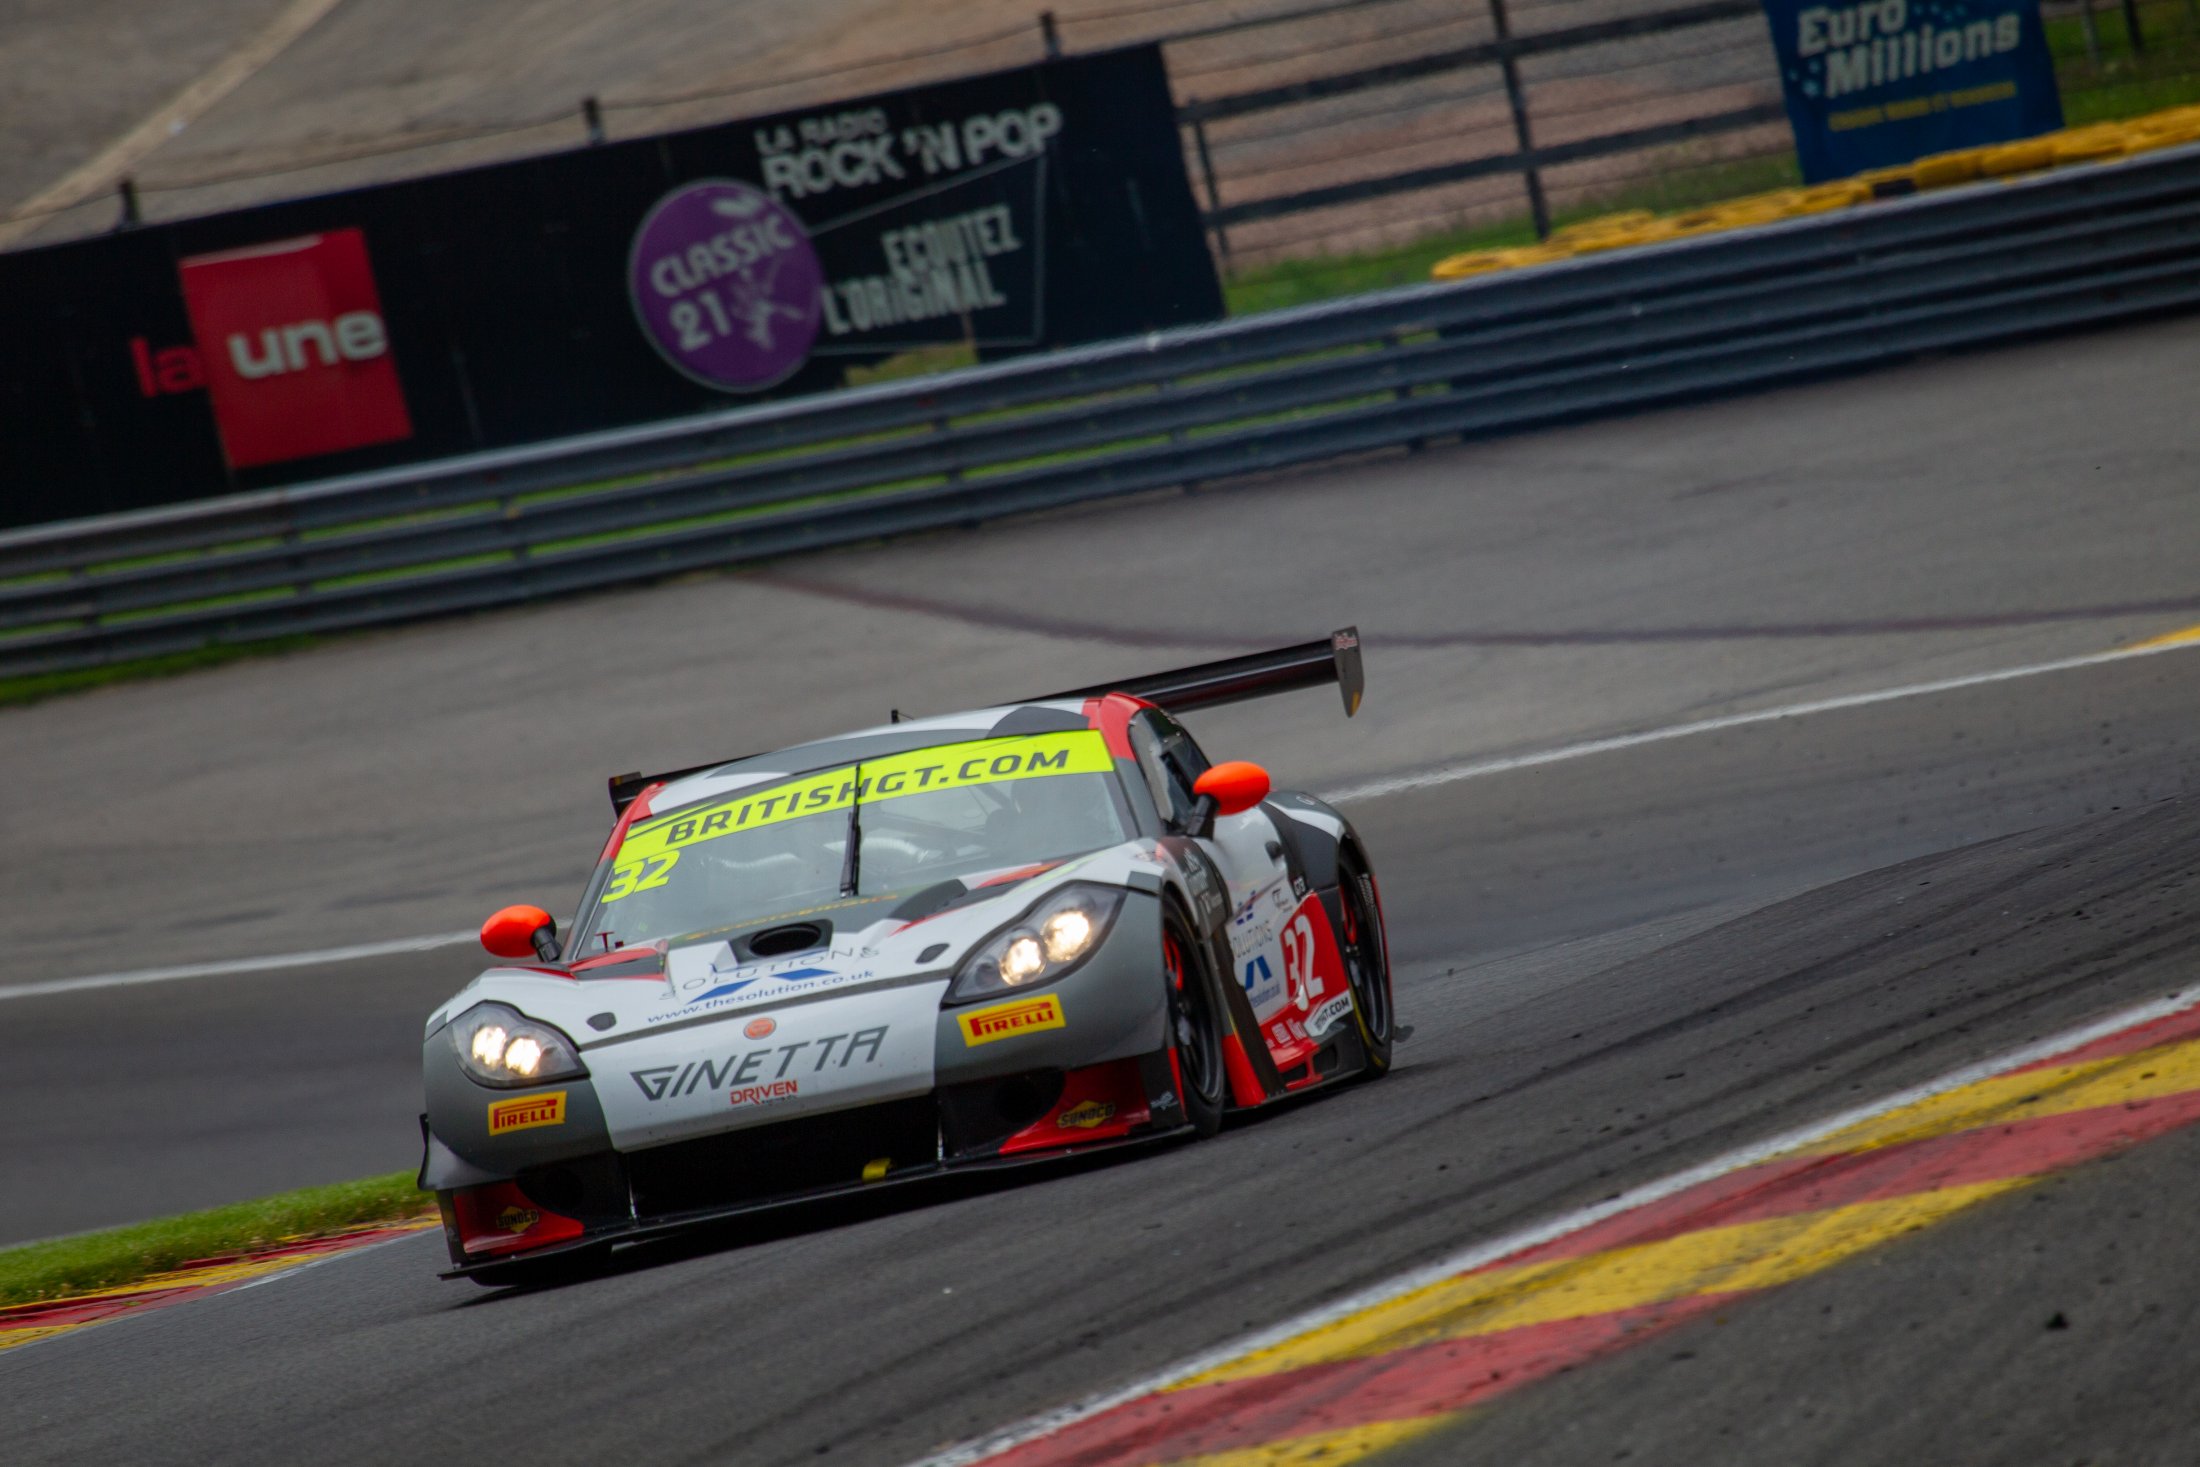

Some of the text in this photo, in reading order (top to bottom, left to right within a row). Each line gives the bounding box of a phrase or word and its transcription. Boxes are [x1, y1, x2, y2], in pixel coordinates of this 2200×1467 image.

[1798, 0, 1909, 56] Euro
[1824, 13, 2021, 98] Millions
[756, 106, 888, 155] LA RADIO
[762, 134, 903, 202] ROCK
[963, 103, 1062, 164] POP
[651, 214, 796, 298] CLASSIC
[669, 291, 732, 352] 21
[130, 310, 386, 397] la une
[666, 749, 1069, 847] BRITISHGT.COM
[601, 849, 681, 903] 32
[1285, 914, 1324, 1011] 32
[648, 970, 875, 1023] www.thesolution.co.uk
[968, 1001, 1055, 1037] PIRELLI
[630, 1025, 890, 1101] GINETTA
[493, 1098, 558, 1130] PIRELLI
[730, 1080, 798, 1106] DRIVEN
[1057, 1102, 1115, 1128] SUNOCO
